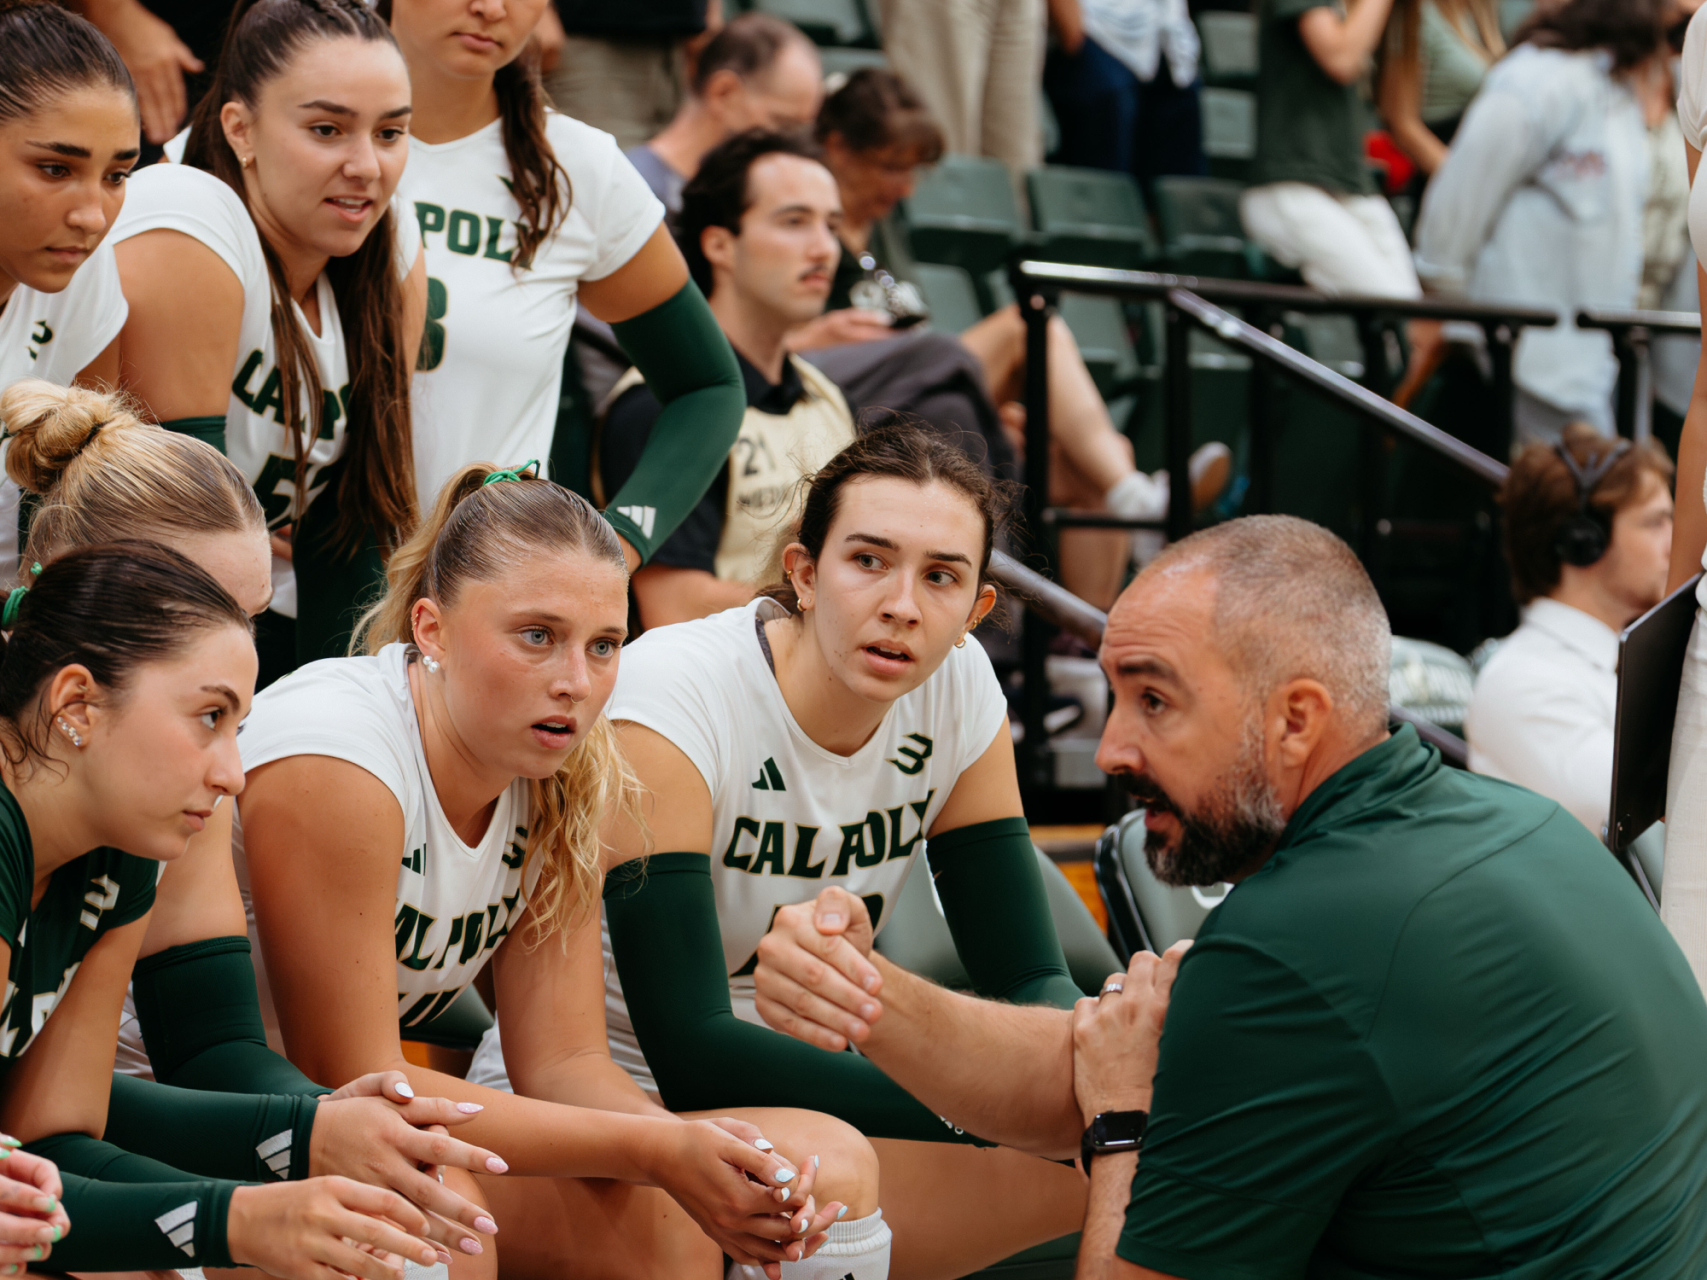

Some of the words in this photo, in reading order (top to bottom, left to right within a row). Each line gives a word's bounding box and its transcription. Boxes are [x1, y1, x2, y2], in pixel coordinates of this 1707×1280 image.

[231, 347, 307, 436] CA
[722, 814, 831, 880] CAL
[829, 787, 938, 878] POLY
[395, 902, 438, 971] AL
